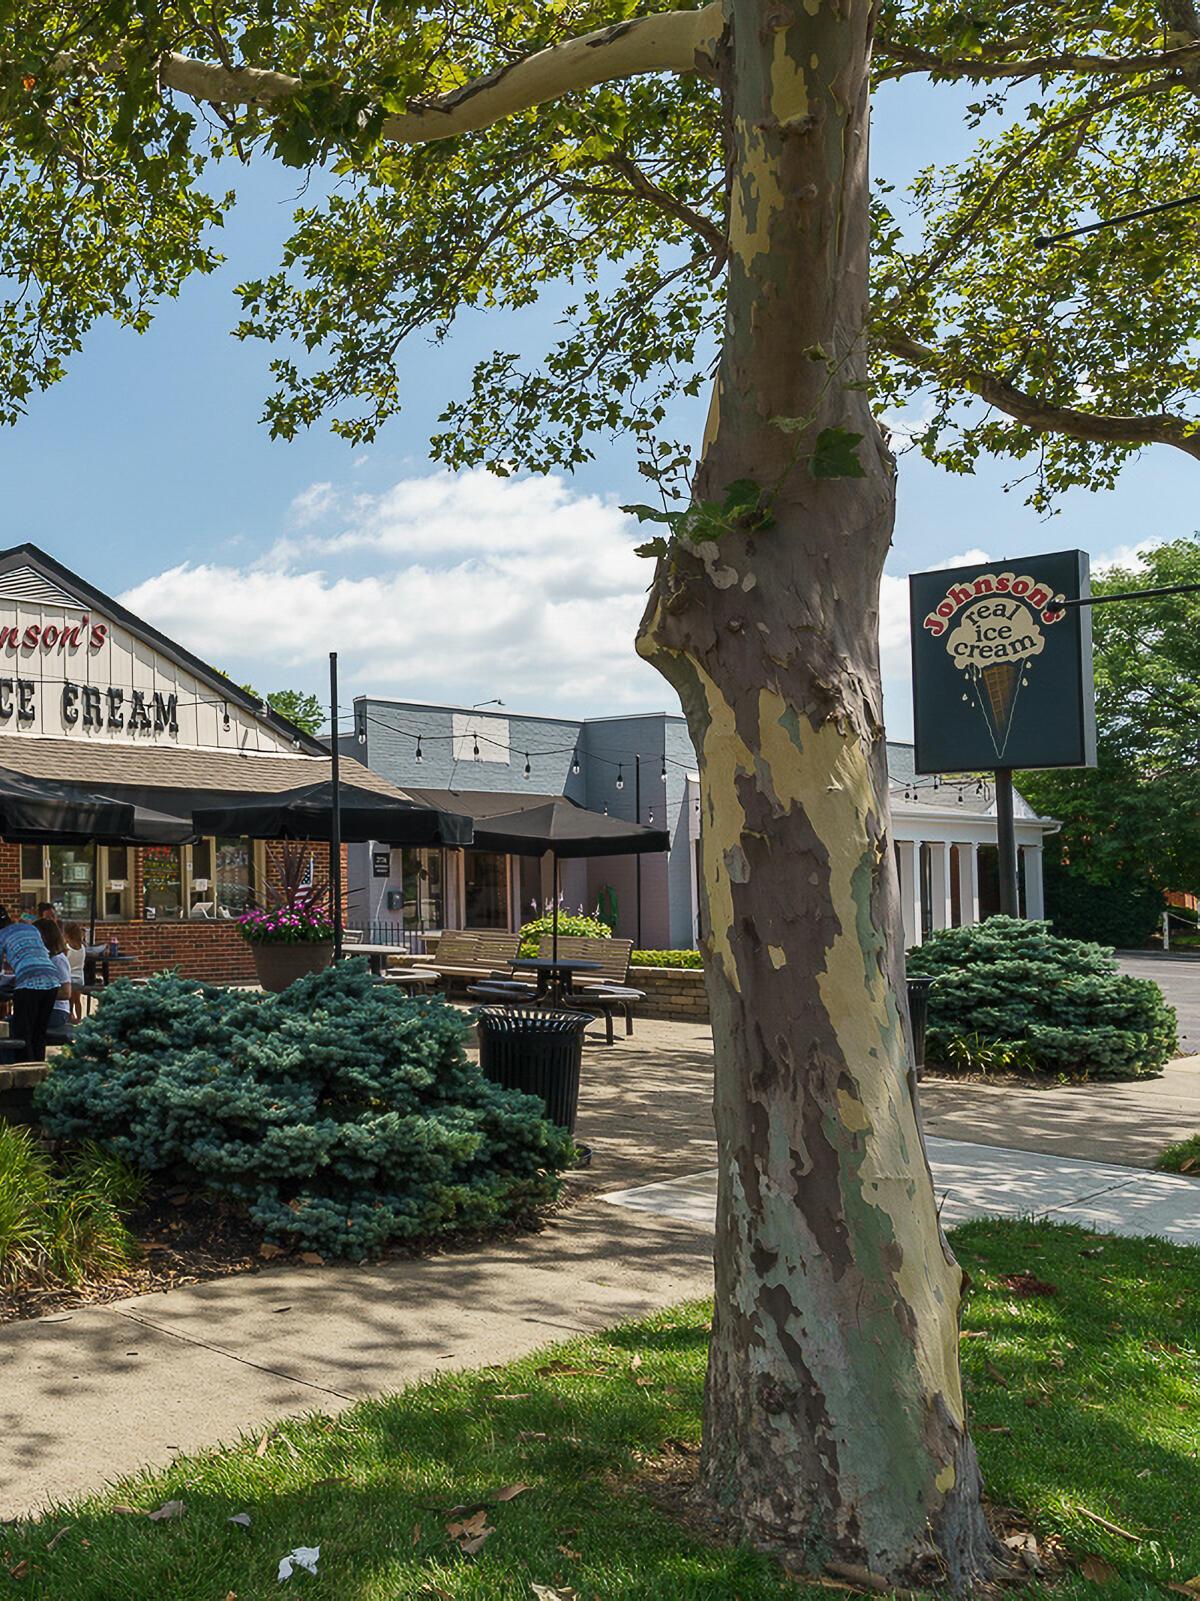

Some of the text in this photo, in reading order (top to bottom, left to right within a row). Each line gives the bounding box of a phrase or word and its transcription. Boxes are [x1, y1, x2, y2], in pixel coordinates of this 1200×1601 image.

[924, 572, 1066, 636] Johnsons
[965, 603, 1022, 626] real
[953, 634, 1037, 659] cream
[975, 625, 1012, 643] ice
[63, 680, 179, 737] CREAM
